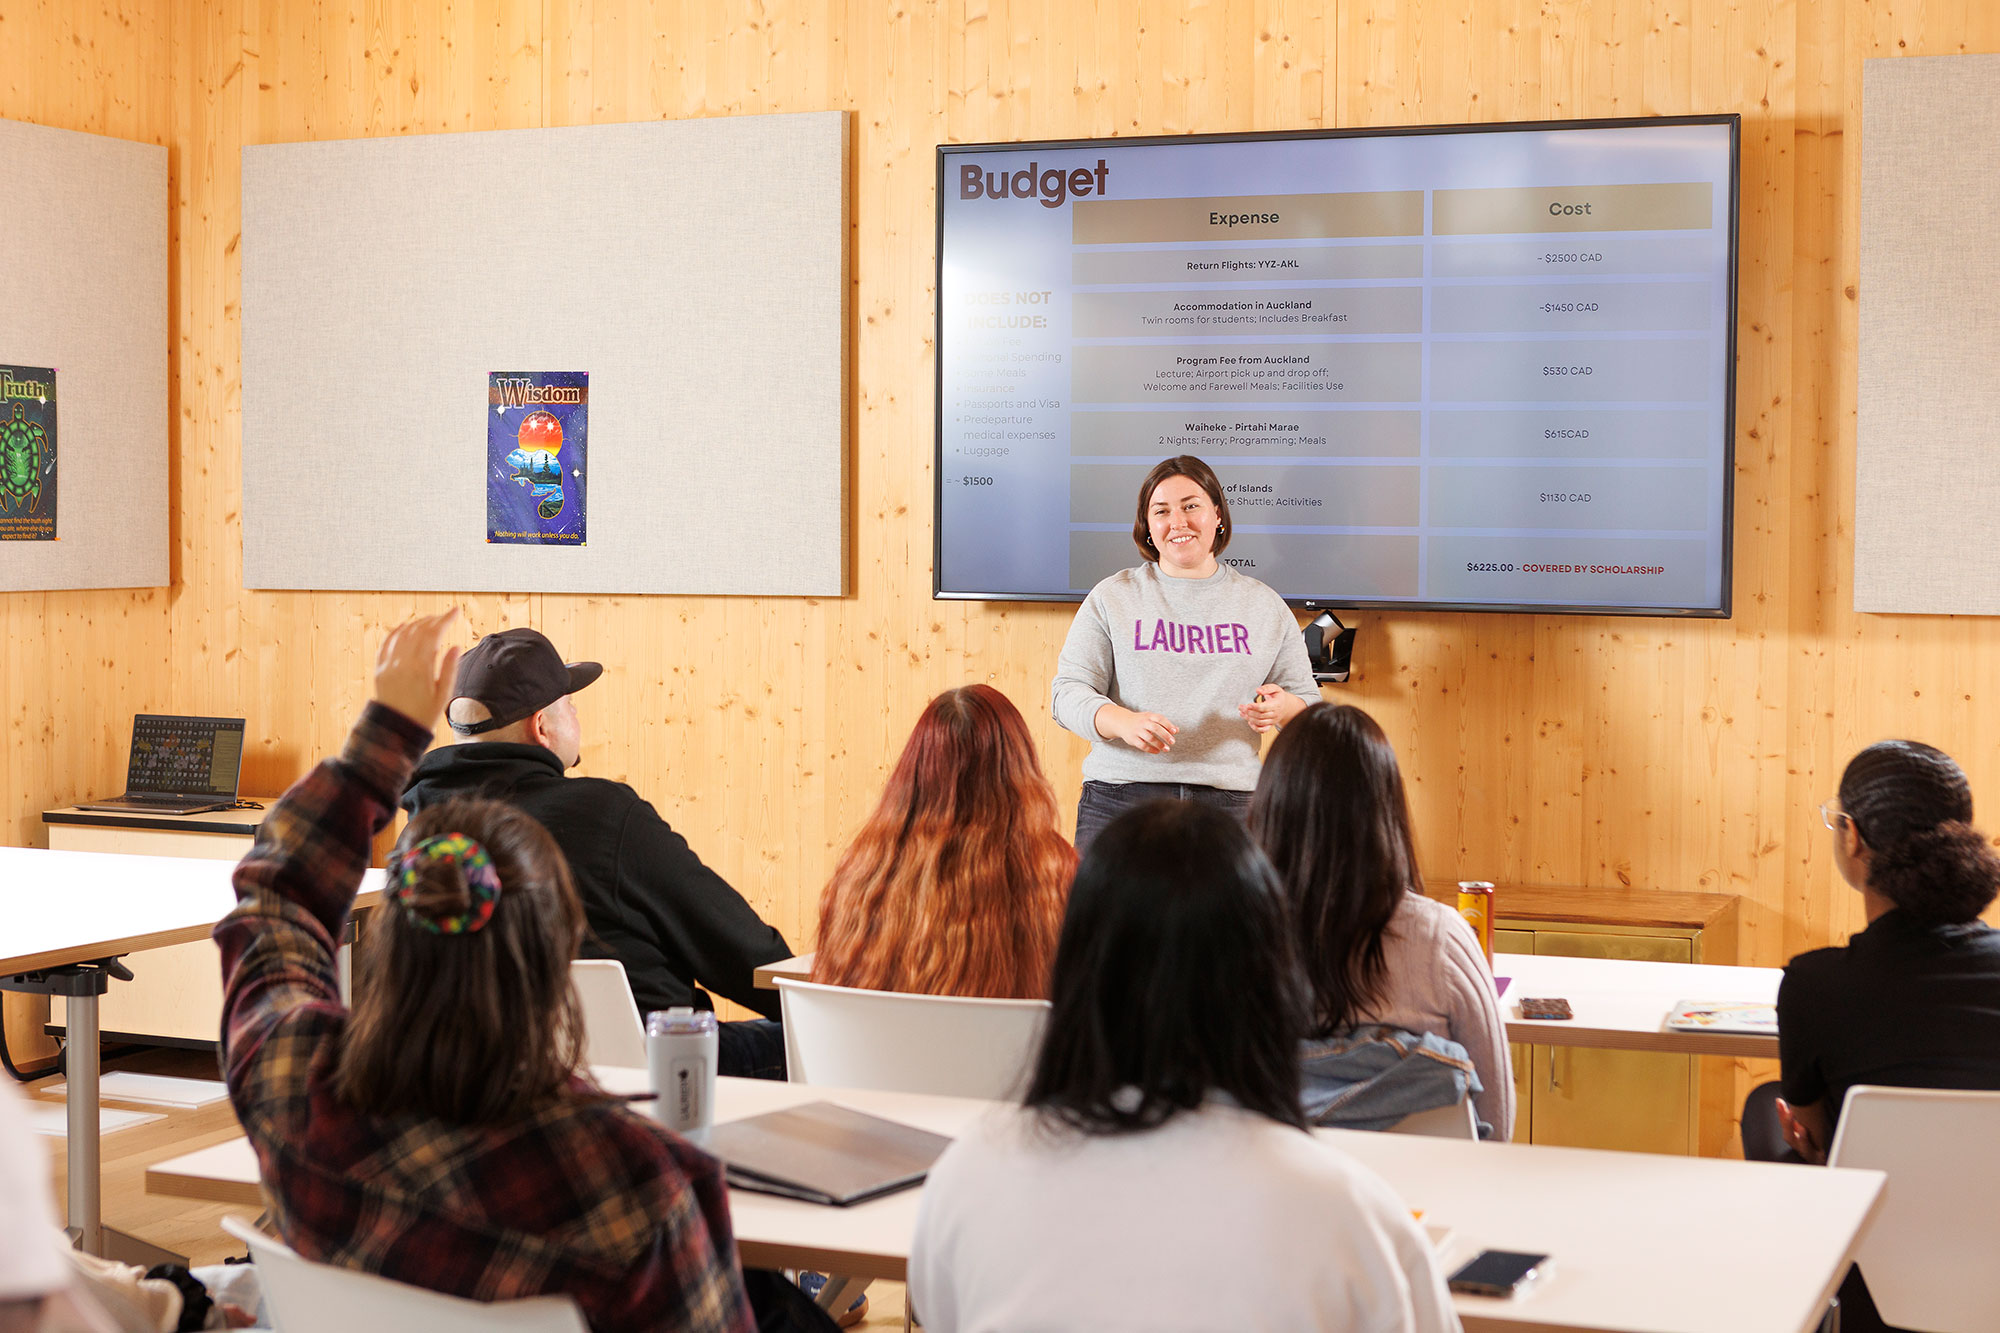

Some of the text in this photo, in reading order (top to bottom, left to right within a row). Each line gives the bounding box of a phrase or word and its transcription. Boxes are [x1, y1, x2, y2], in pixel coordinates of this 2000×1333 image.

[960, 159, 1109, 208] Budget
[1549, 202, 1592, 216] Cost
[1209, 212, 1280, 228] Expense
[1545, 253, 1578, 263] $2500
[1580, 253, 1602, 262] CAD
[1187, 260, 1300, 272] Return Flights: YYZ-AKL
[964, 291, 1052, 305] DOES NOT
[1174, 301, 1312, 312] Accommodation in Auckland
[1576, 302, 1599, 312] CAD
[968, 315, 1047, 328] INCLUDE:
[1142, 316, 1163, 325] Twin
[1197, 316, 1210, 324] for
[1212, 315, 1257, 324] students;
[1259, 314, 1300, 323] Includes
[1302, 314, 1348, 323] Breakfast
[1012, 352, 1062, 363] Spending
[1176, 356, 1310, 367] Program Fee from Auckland
[996, 368, 1026, 378] Meals
[1156, 368, 1329, 380] Lecture; Airport pick up and drop off;
[1542, 366, 1593, 376] $530 CAD
[964, 384, 1015, 393] Insurance
[1144, 382, 1344, 392] Welcome and Farewell Meals; Facilities Use
[496, 378, 580, 408] Wisdom
[964, 399, 1060, 410] Passports and Visa
[964, 415, 1032, 426] Predeparture
[1185, 423, 1226, 432] Waiheke
[1235, 423, 1266, 432] Pirtahi
[1269, 423, 1300, 432] Marae
[964, 430, 1056, 442] medical expenses
[1544, 429, 1590, 439] $615CAD
[1158, 436, 1326, 446] 2 Nights; Ferry; Programming; Meals
[964, 446, 1010, 457] Luggage
[963, 476, 994, 486] $1500
[1226, 484, 1236, 492] of
[1239, 484, 1272, 493] Islands
[1237, 497, 1274, 506] Shuttle;
[1276, 498, 1322, 506] Acitivities
[1540, 492, 1592, 502] $1130 CAD
[494, 530, 516, 539] Nothing
[1224, 559, 1256, 568] TOTAL
[1466, 562, 1514, 572] $6225.00
[1522, 564, 1572, 574] COVERED
[1574, 564, 1588, 574] BY
[1590, 564, 1664, 574] SCHOLARSHIP
[1134, 618, 1252, 656] LAURIER
